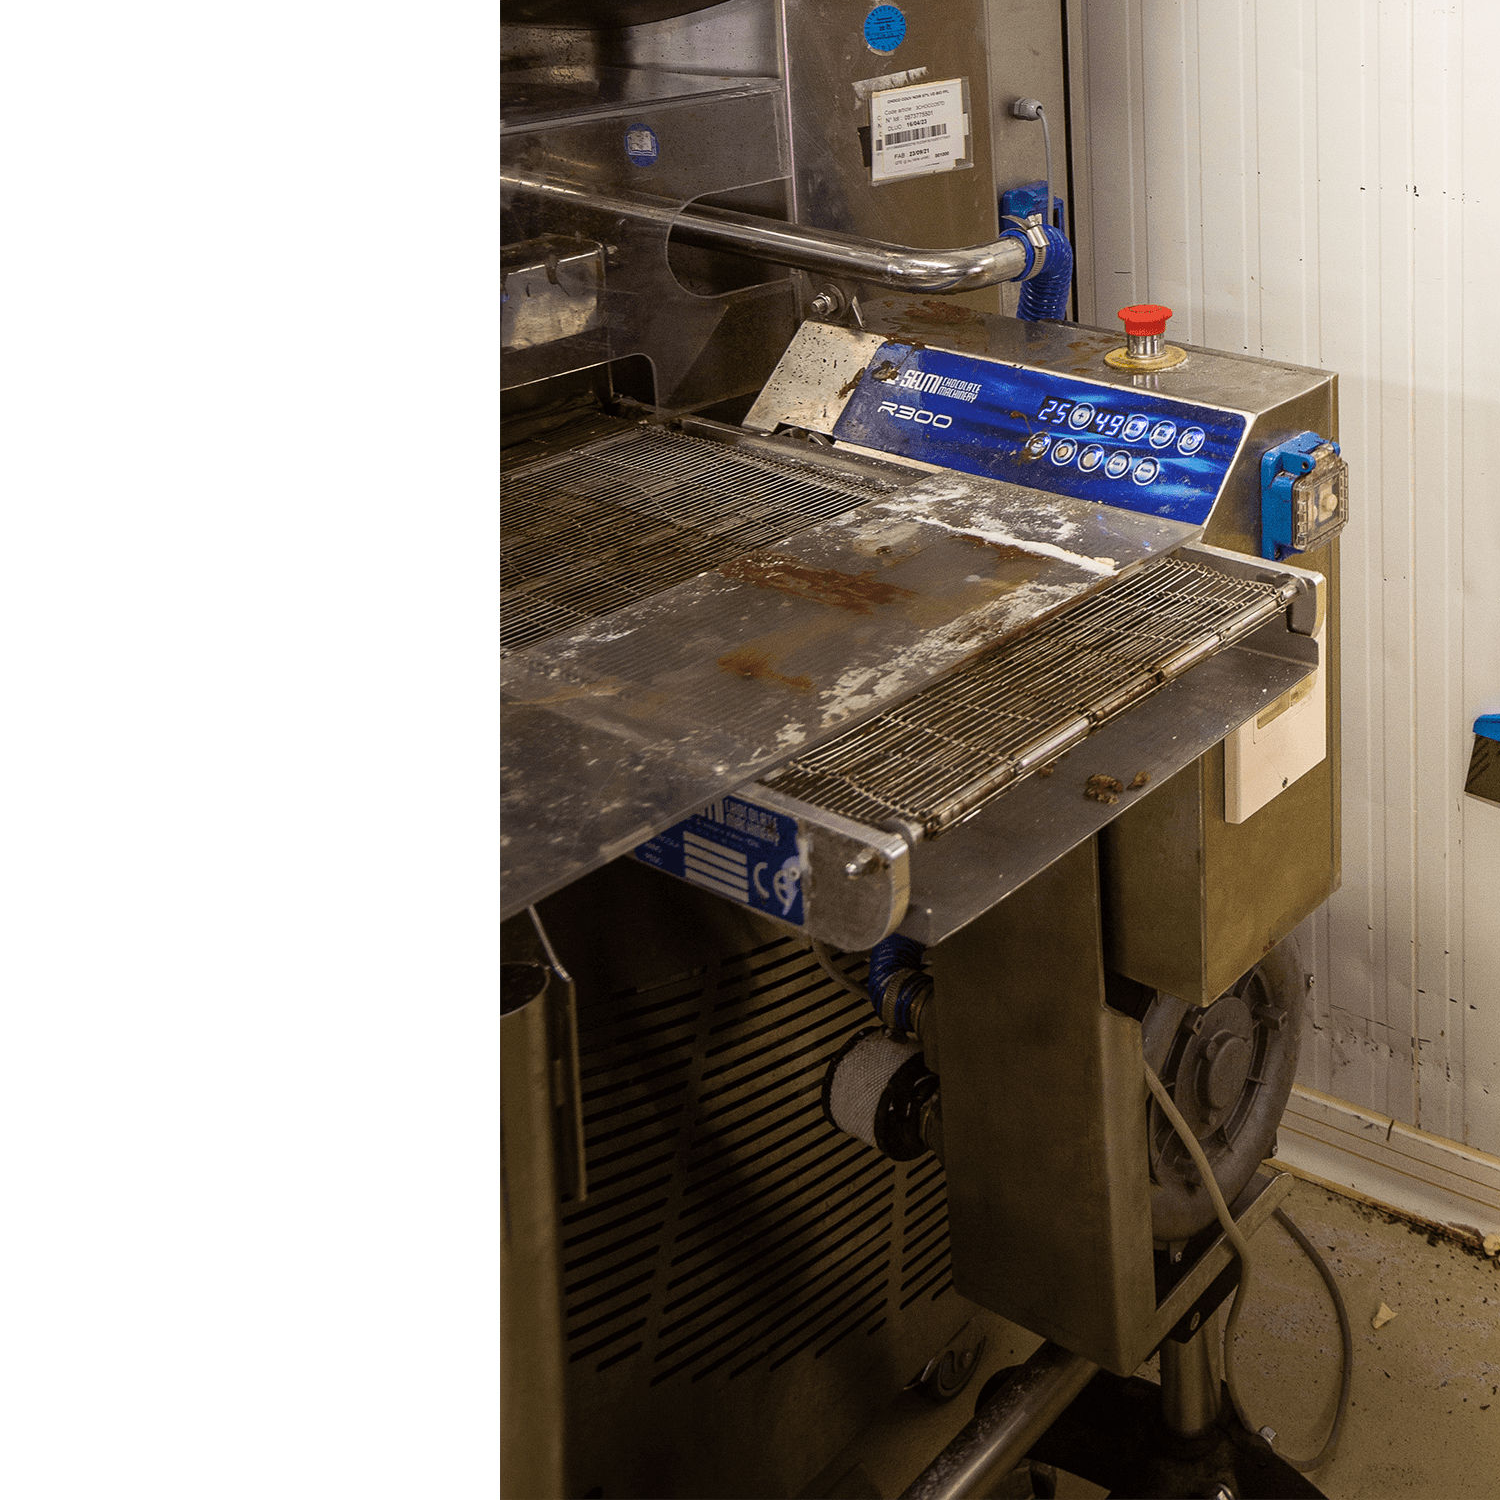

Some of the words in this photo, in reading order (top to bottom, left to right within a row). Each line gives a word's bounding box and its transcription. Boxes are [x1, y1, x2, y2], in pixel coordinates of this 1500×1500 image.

[887, 124, 902, 132] DLUO
[894, 152, 906, 160] FAB
[899, 369, 943, 395] SELMI
[941, 377, 982, 394] CHOCOLATE
[936, 386, 978, 403] MACHINERY
[877, 400, 953, 429] R300
[1037, 400, 1072, 424] 25
[1093, 412, 1126, 437] 49
